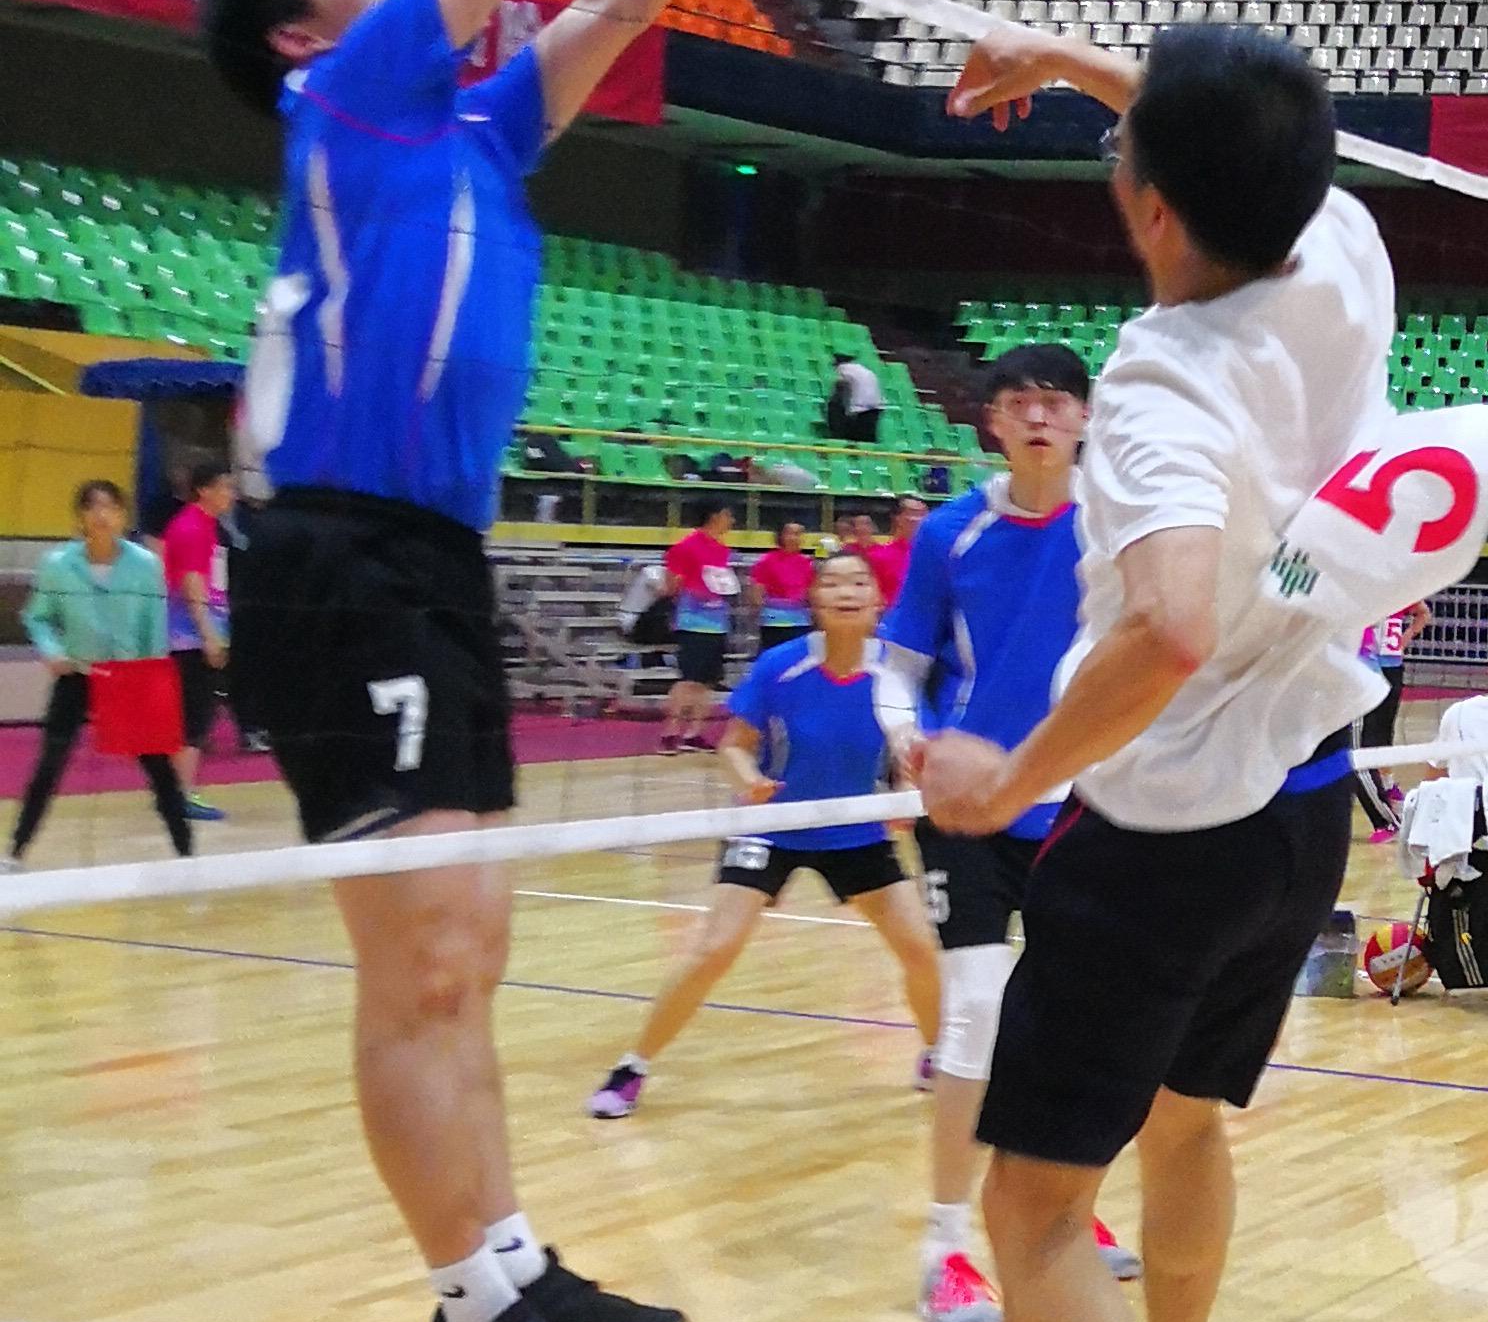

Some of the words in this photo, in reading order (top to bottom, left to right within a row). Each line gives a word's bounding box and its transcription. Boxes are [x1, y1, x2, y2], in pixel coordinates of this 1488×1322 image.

[1315, 445, 1478, 554] 5
[1385, 621, 1402, 652] 5
[366, 674, 429, 773] 7
